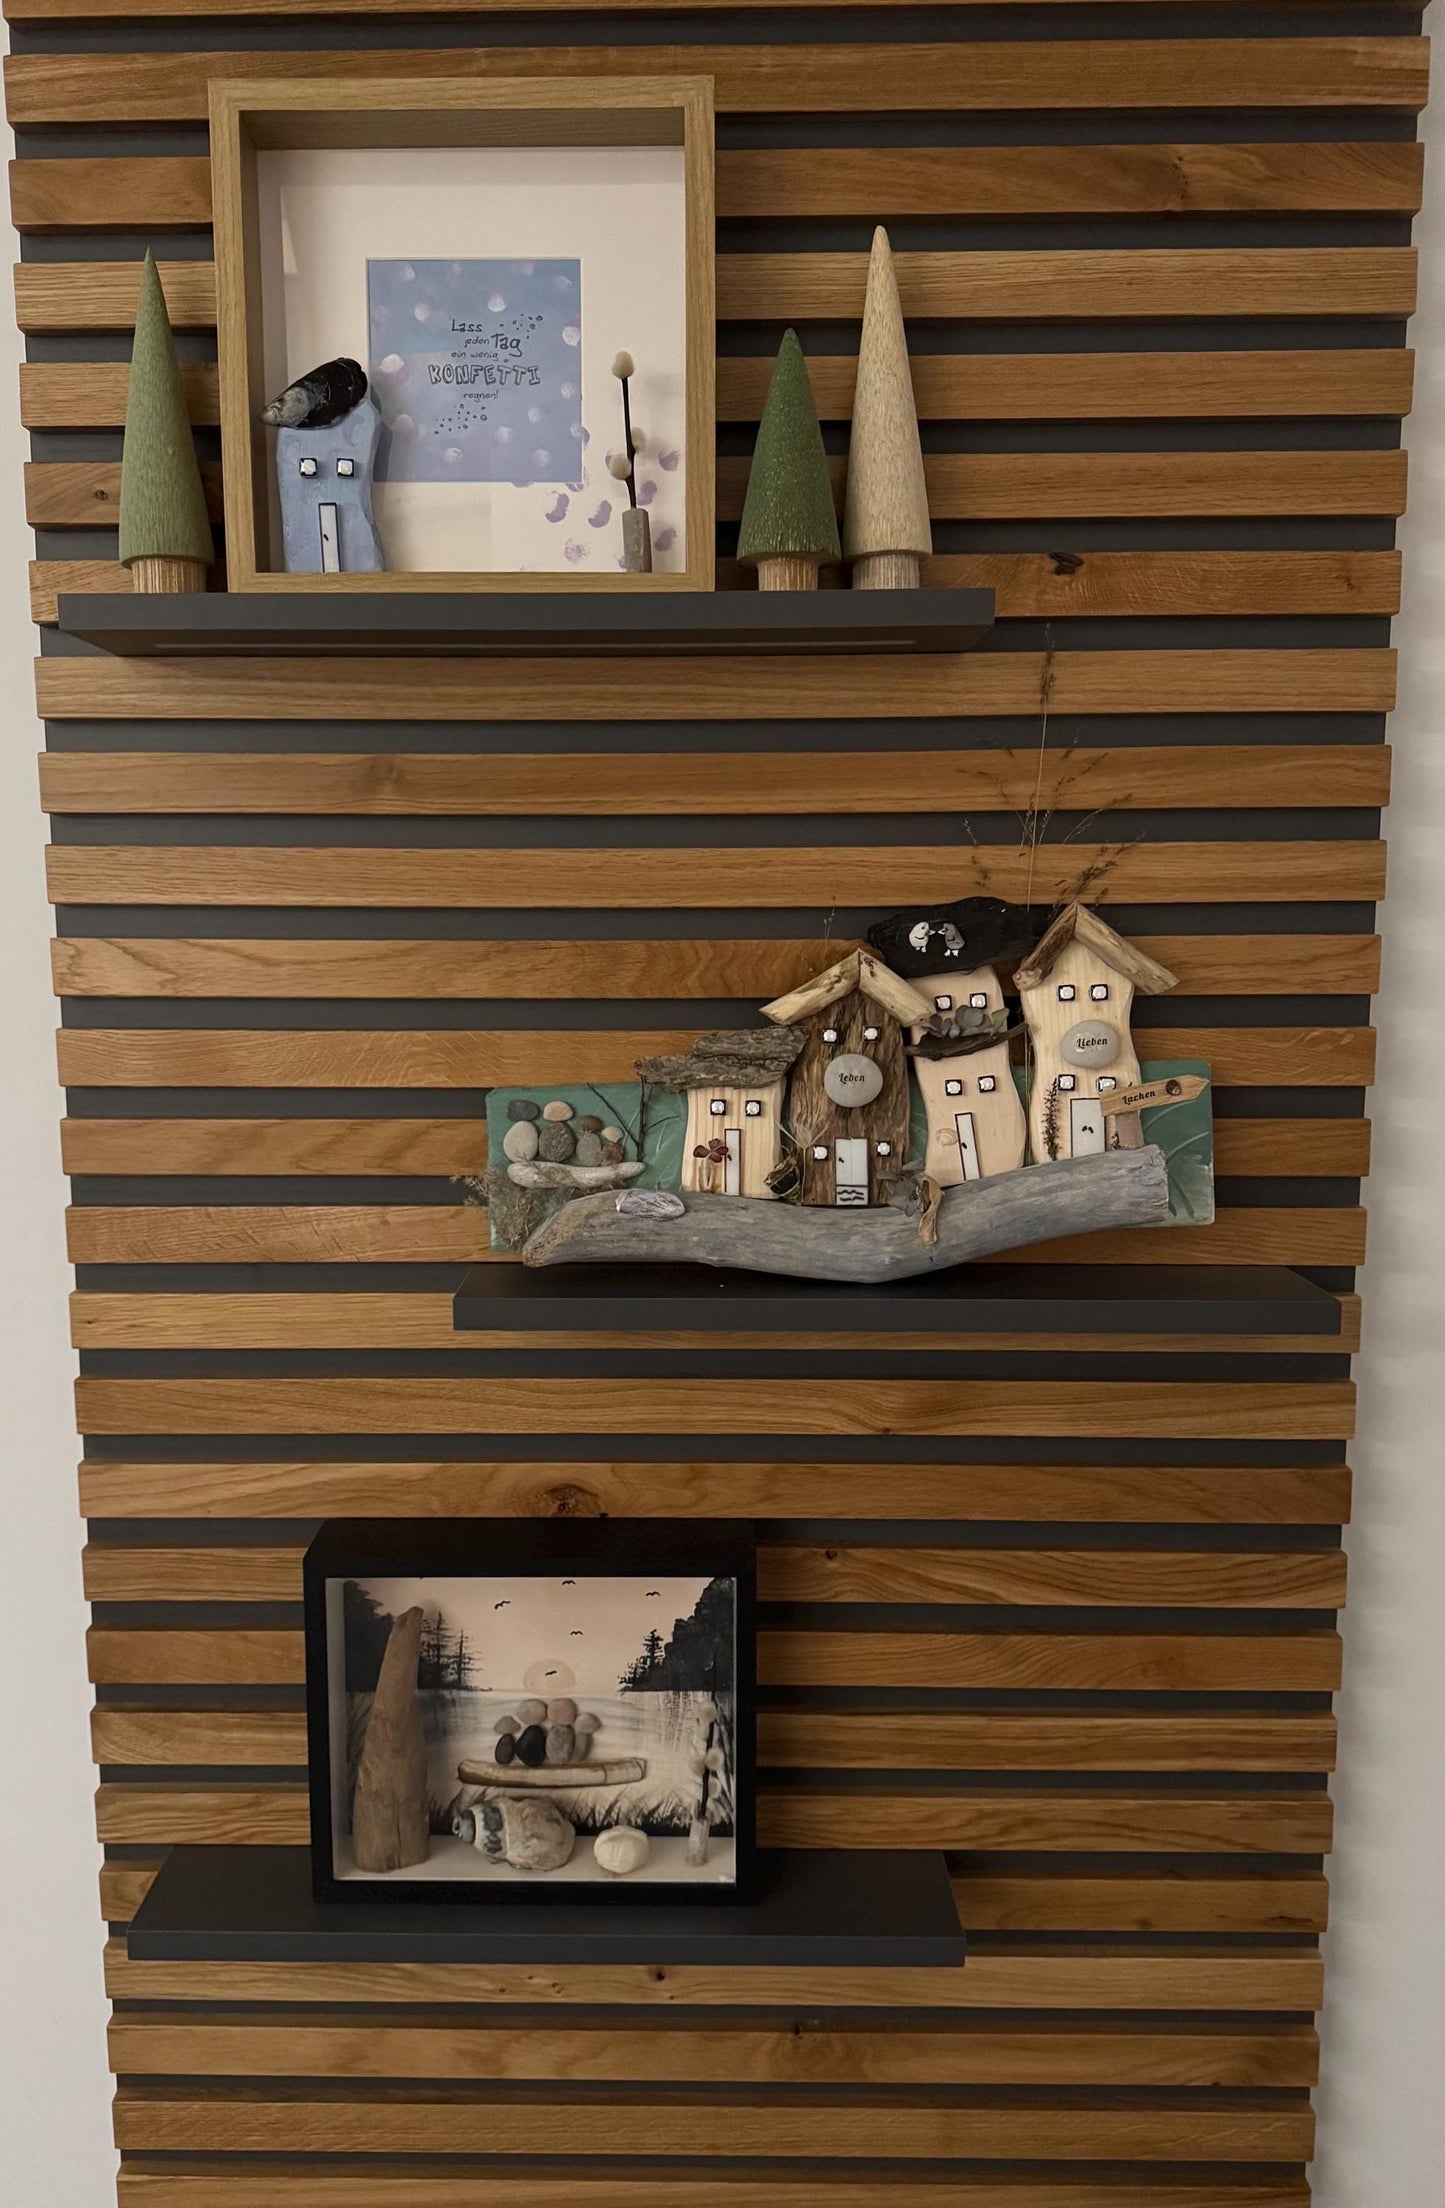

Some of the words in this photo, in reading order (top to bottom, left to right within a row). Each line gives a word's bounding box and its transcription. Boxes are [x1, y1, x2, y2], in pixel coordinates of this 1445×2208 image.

[451, 319, 482, 332] Lass
[464, 336, 490, 348] jeden
[490, 333, 523, 358] Tag
[451, 350, 466, 358] ein
[470, 351, 499, 362] wenig
[428, 363, 541, 386] KONFETTI
[463, 389, 499, 403] regnen!
[1076, 1038, 1108, 1049] Lieben
[838, 1072, 865, 1085] Leben
[1121, 1090, 1156, 1105] Lachen
